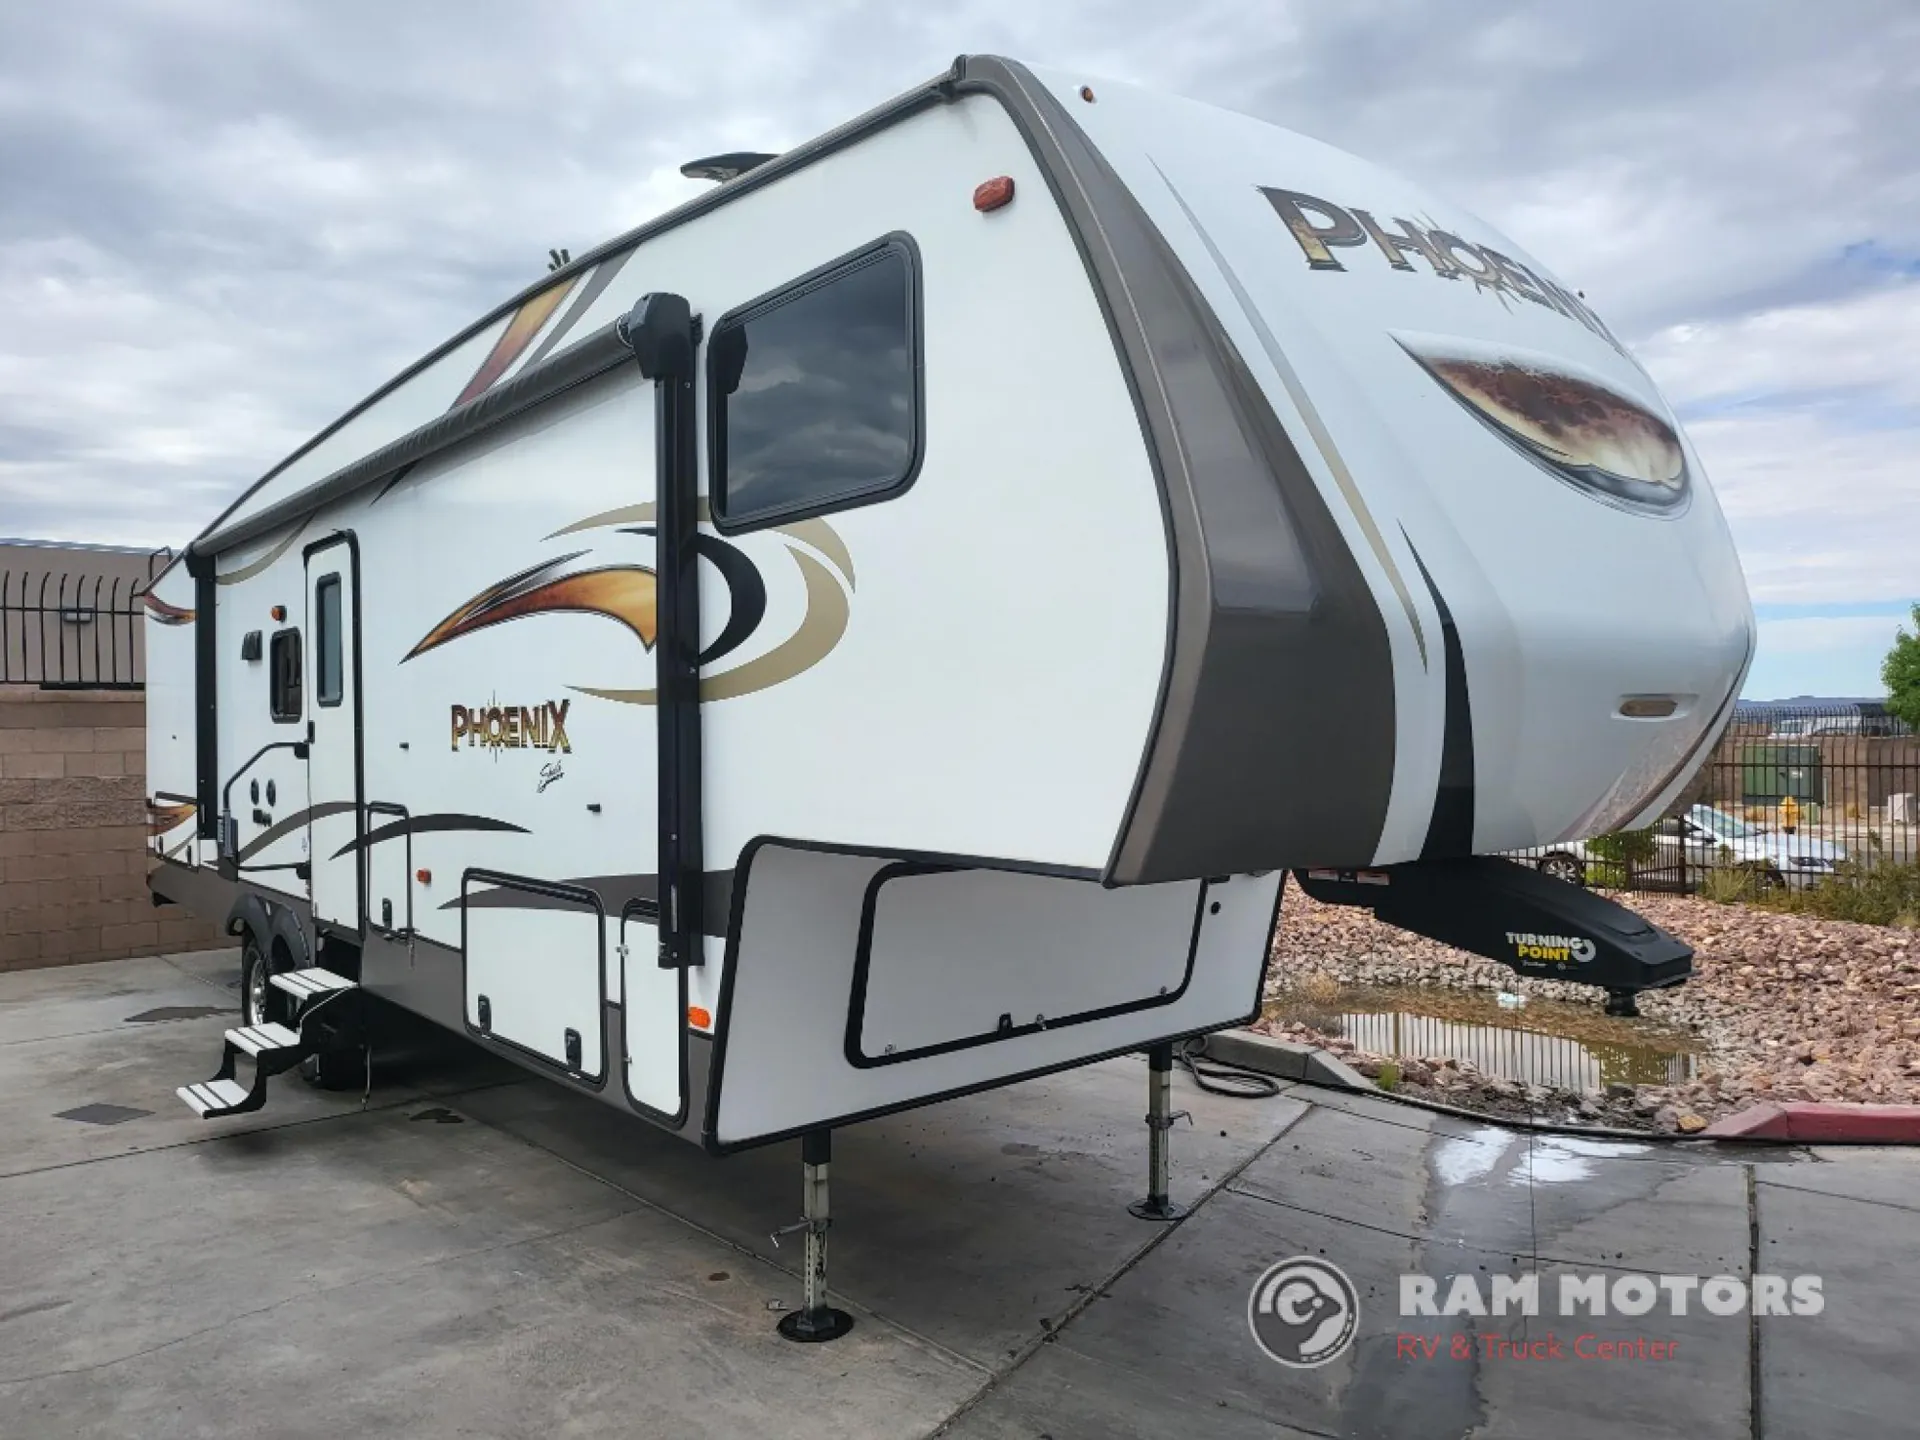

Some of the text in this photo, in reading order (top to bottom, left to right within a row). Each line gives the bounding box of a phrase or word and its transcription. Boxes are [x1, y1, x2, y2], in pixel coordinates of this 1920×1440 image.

[451, 699, 572, 754] PHOENIX
[1505, 931, 1583, 951] TURNING
[1518, 943, 1572, 961] POINT
